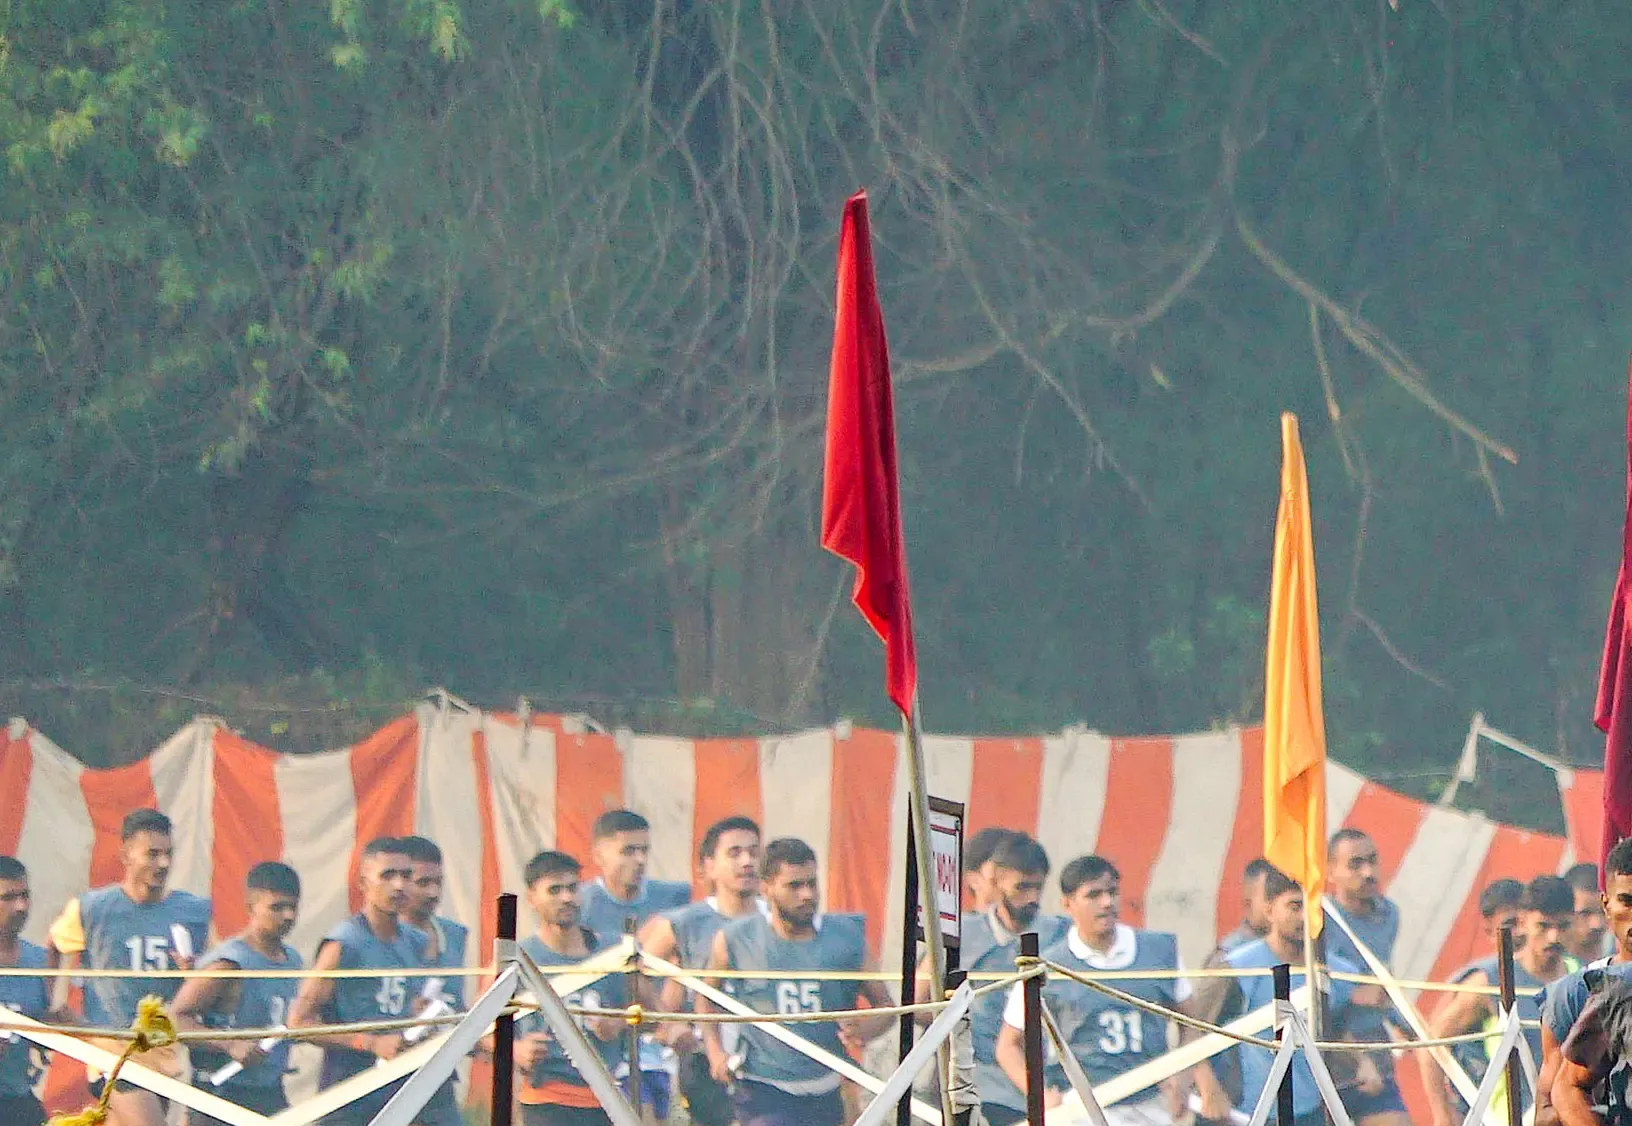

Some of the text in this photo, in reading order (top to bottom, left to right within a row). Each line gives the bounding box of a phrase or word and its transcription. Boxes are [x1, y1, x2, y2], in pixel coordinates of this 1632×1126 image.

[125, 934, 169, 972] 15
[776, 981, 822, 1024] 65
[1098, 1009, 1143, 1054] 31
